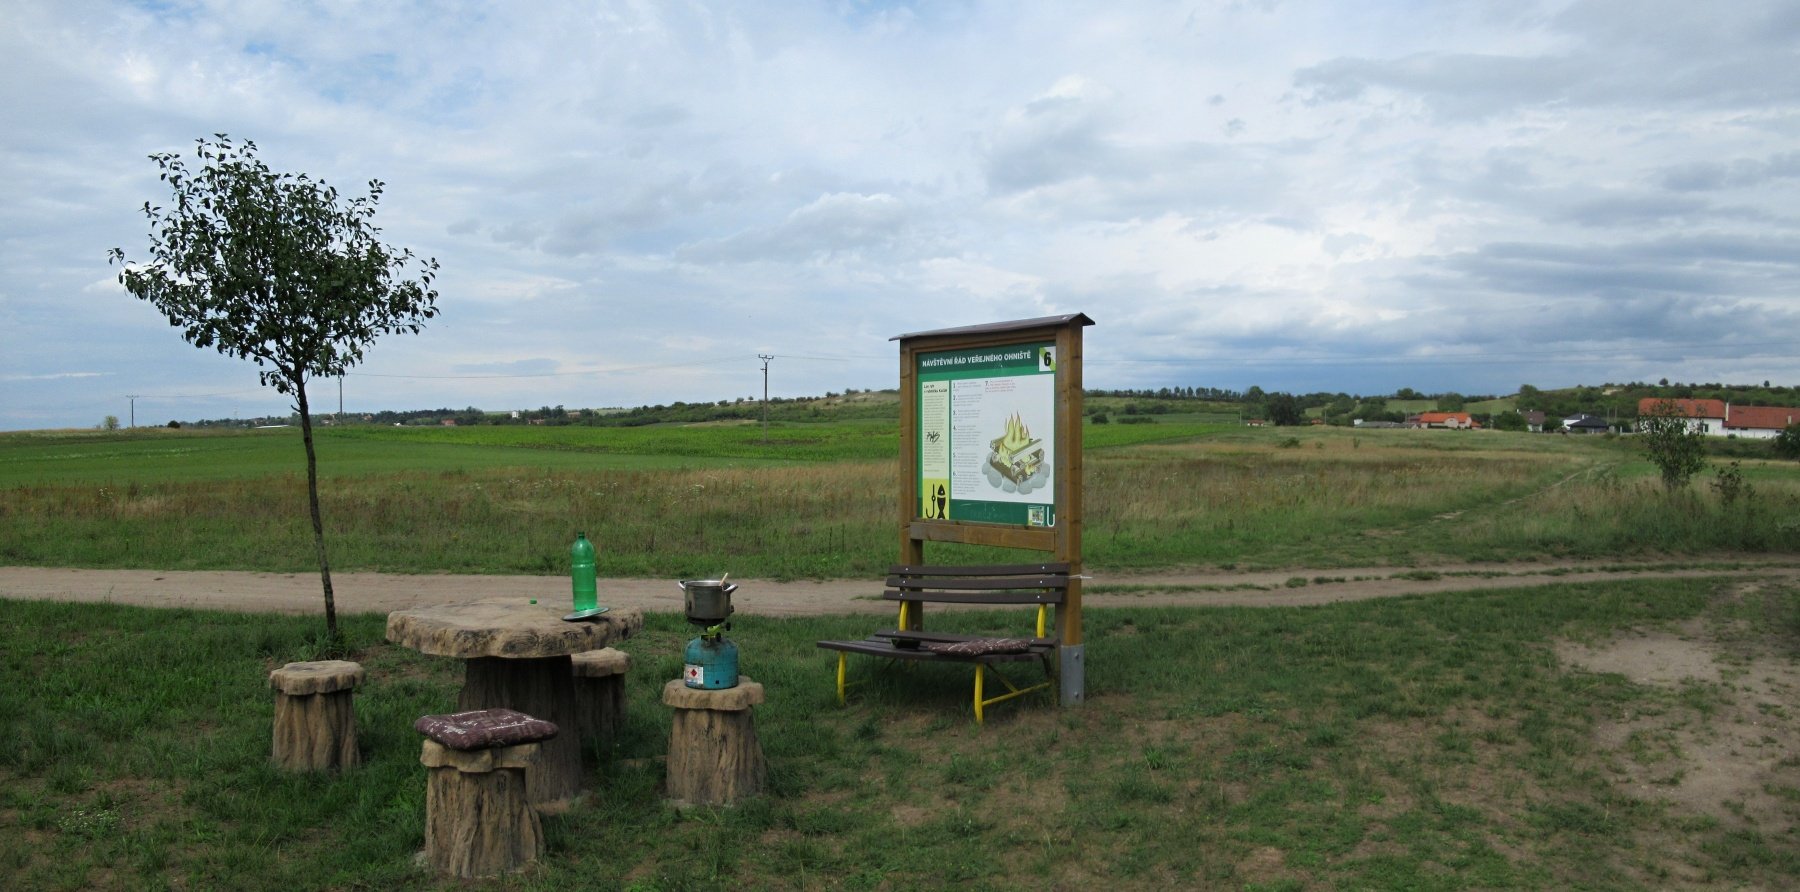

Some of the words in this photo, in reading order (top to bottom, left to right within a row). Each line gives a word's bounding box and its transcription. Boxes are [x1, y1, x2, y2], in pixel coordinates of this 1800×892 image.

[922, 356, 953, 367] NÁVŠTĚVNÍ
[954, 355, 966, 365] ŘÁD
[967, 352, 1002, 364] VEŘEJNÉHO
[1004, 350, 1031, 360] OHNIŠTĚ
[1044, 352, 1052, 366] 6
